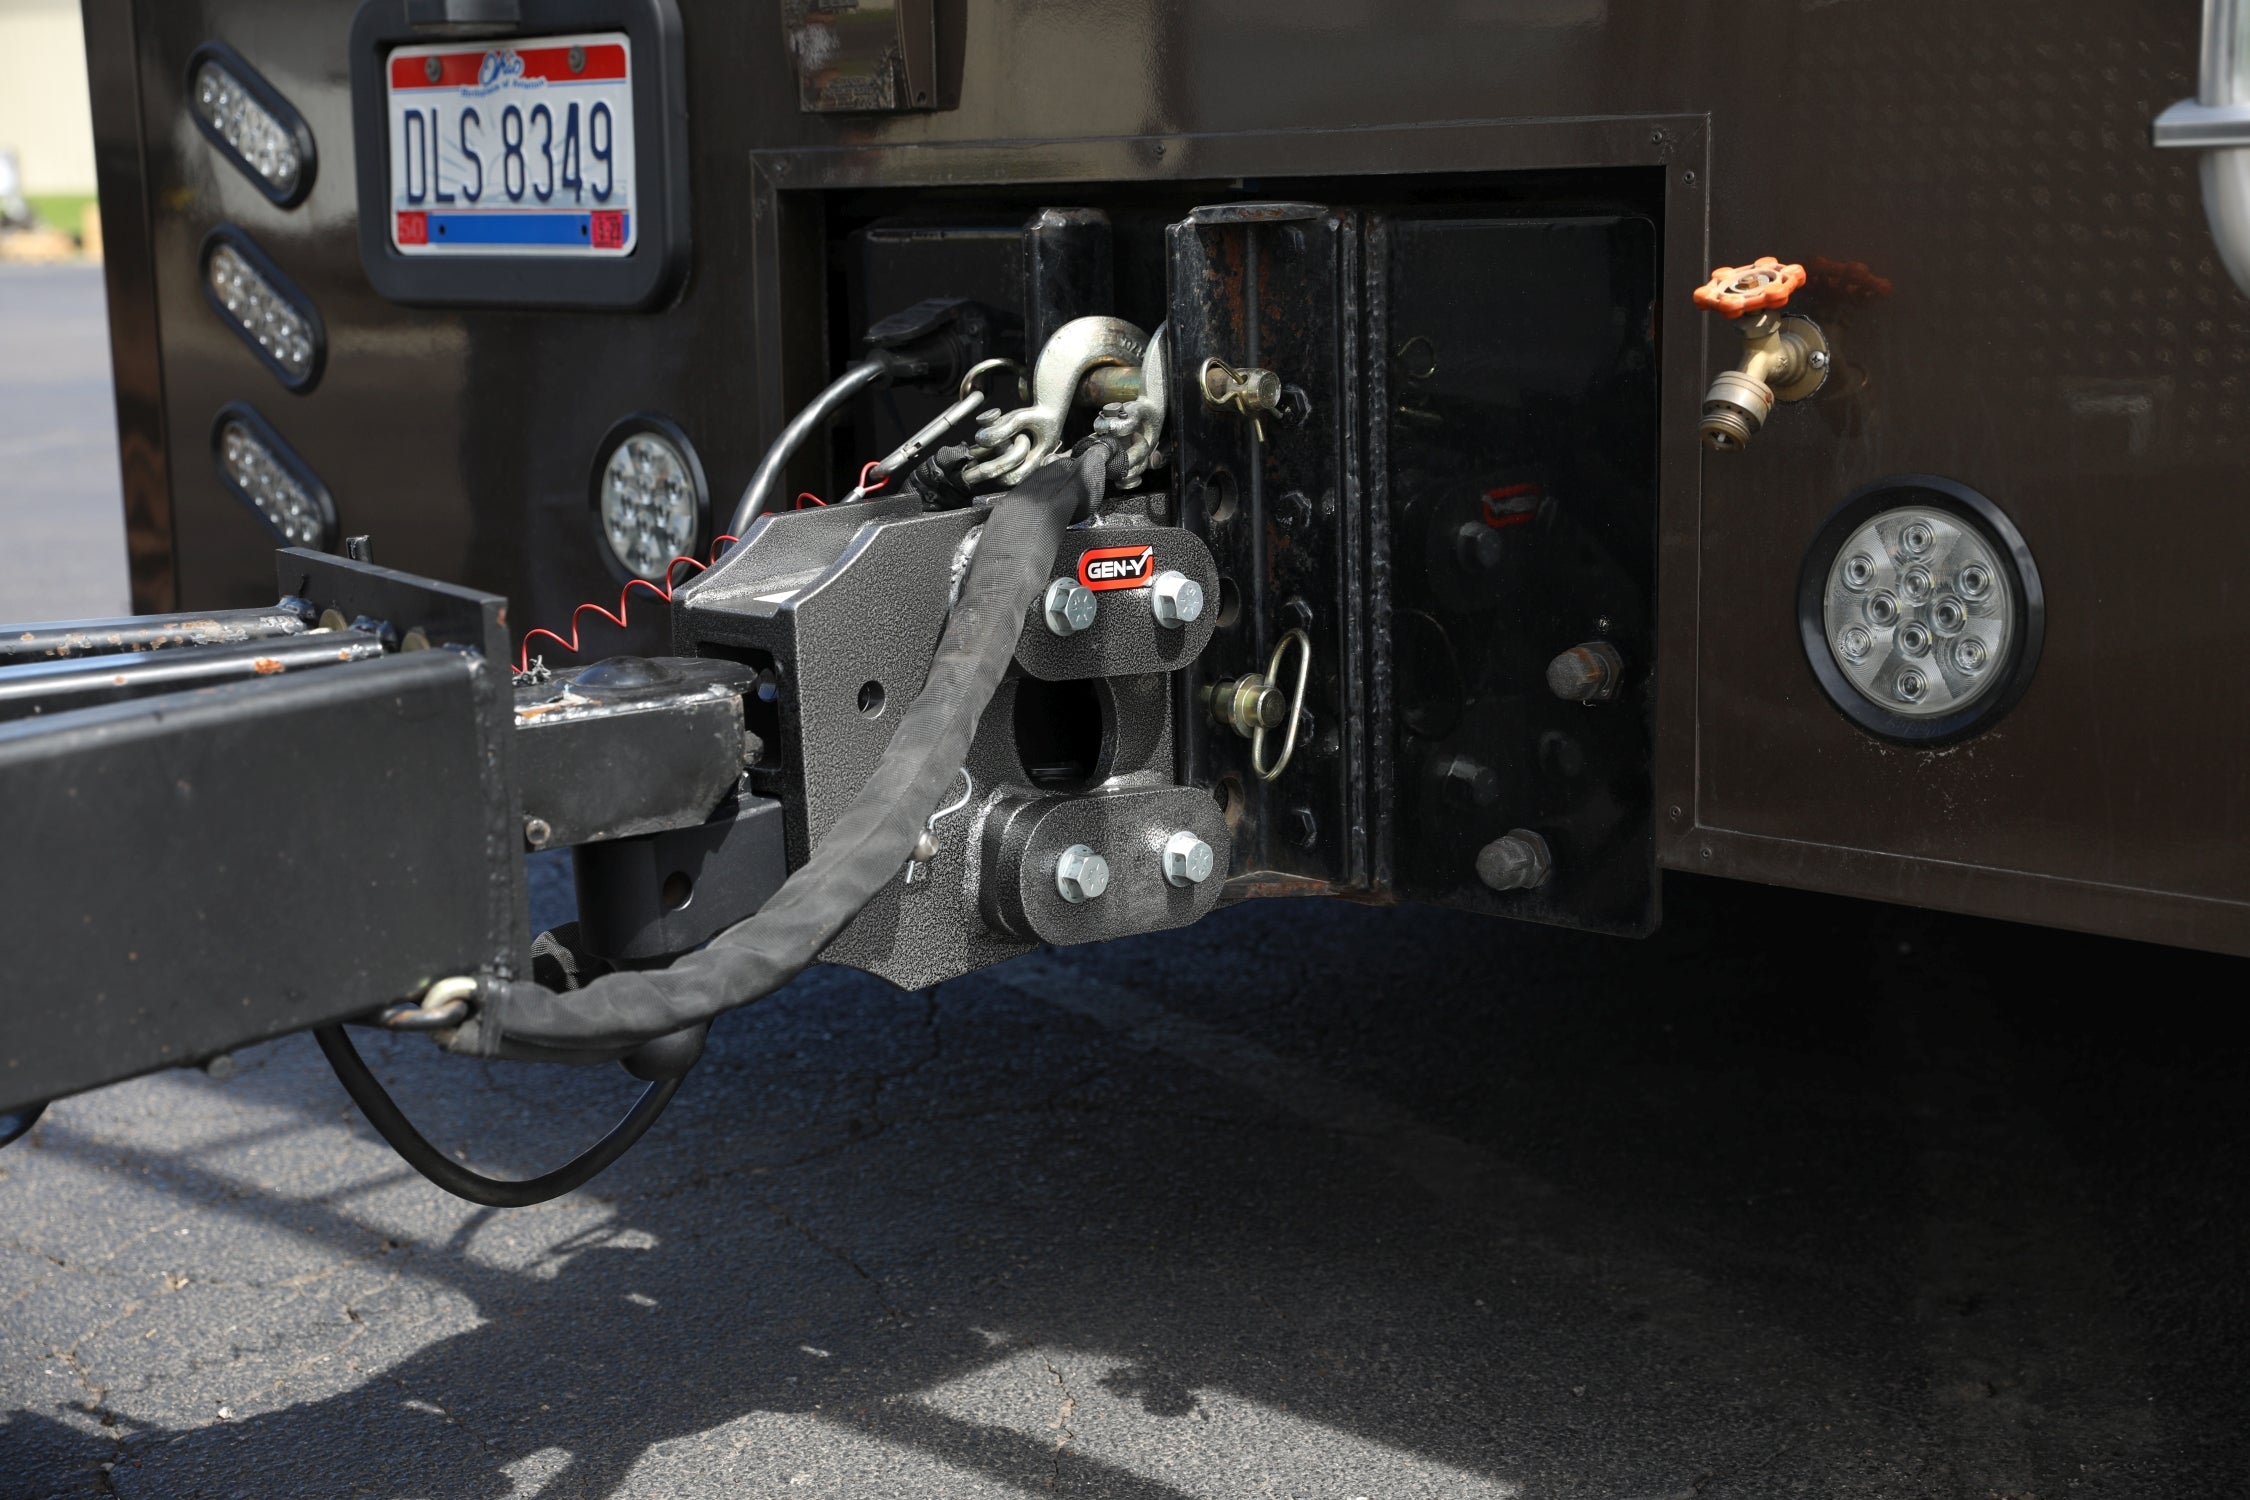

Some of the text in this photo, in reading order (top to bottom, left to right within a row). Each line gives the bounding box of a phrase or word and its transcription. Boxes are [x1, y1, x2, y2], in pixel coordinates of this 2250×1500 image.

[480, 50, 522, 87] Ohio
[404, 101, 614, 205] DLS 8349
[1088, 549, 1150, 579] GEN-Y
